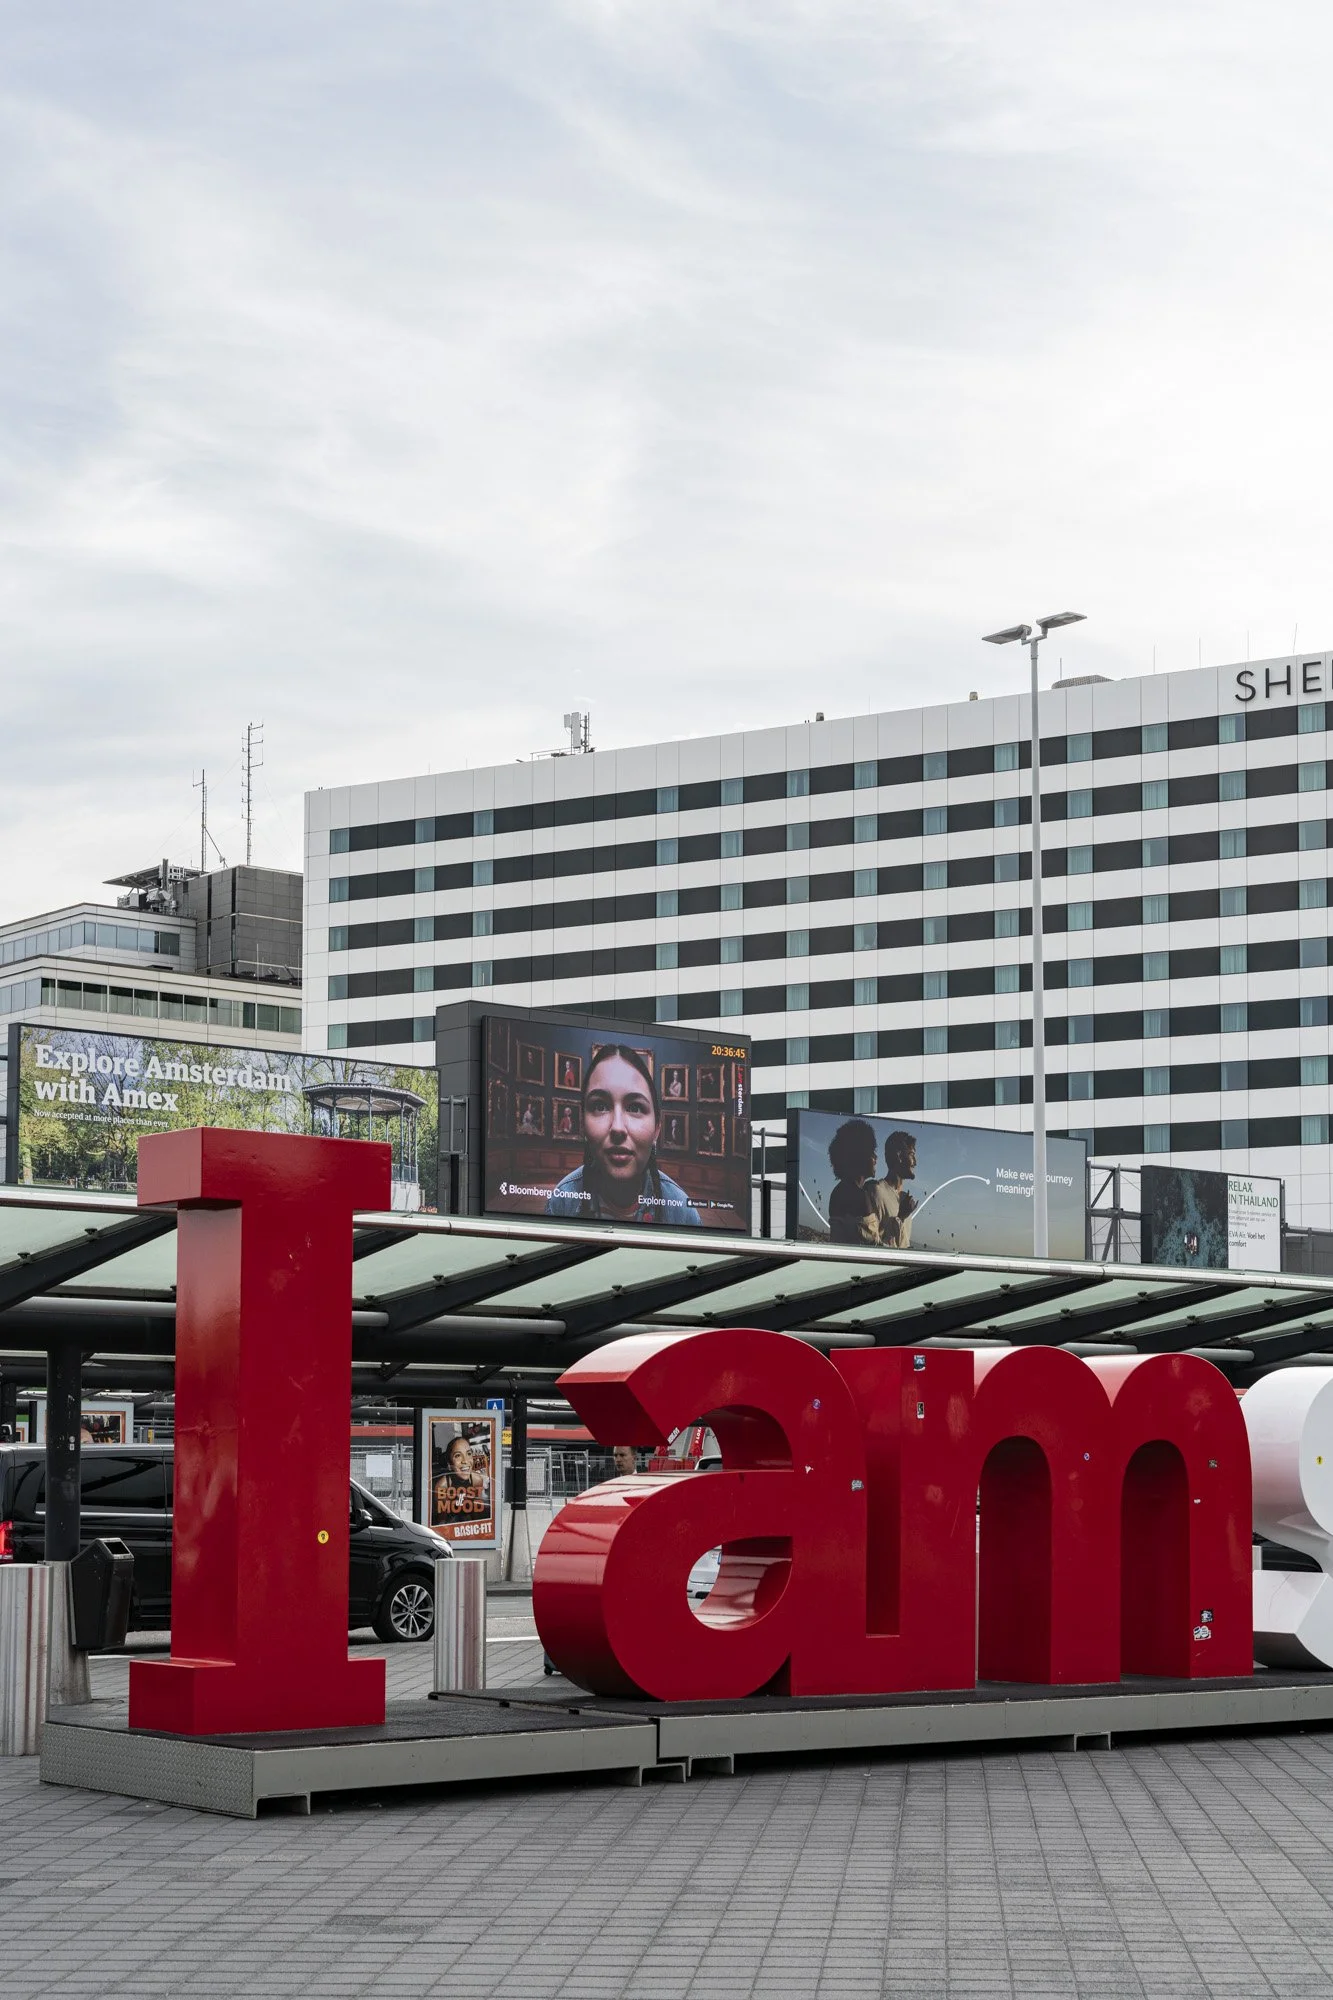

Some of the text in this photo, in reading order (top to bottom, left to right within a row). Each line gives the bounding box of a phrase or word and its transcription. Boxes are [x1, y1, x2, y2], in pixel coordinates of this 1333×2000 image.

[1235, 660, 1333, 702] SHE
[711, 1045, 746, 1059] 20:36:45
[35, 1043, 292, 1093] Explore Amsterdam
[34, 1076, 179, 1113] with Amex
[33, 1108, 170, 1128] Now accepted at more places than ever.
[996, 1167, 1073, 1187] Make eve ourney
[509, 1184, 591, 1200] Bloomberg Connects
[996, 1184, 1036, 1198] meaningf
[1228, 1180, 1253, 1193] RELAX
[637, 1194, 666, 1206] Explore
[1228, 1193, 1279, 1208] IN THAILAND
[1257, 1232, 1265, 1240] het
[1228, 1240, 1247, 1248] comfort
[129, 1127, 391, 1734] I
[437, 1486, 483, 1500] BOOST
[437, 1500, 485, 1514] MOOD
